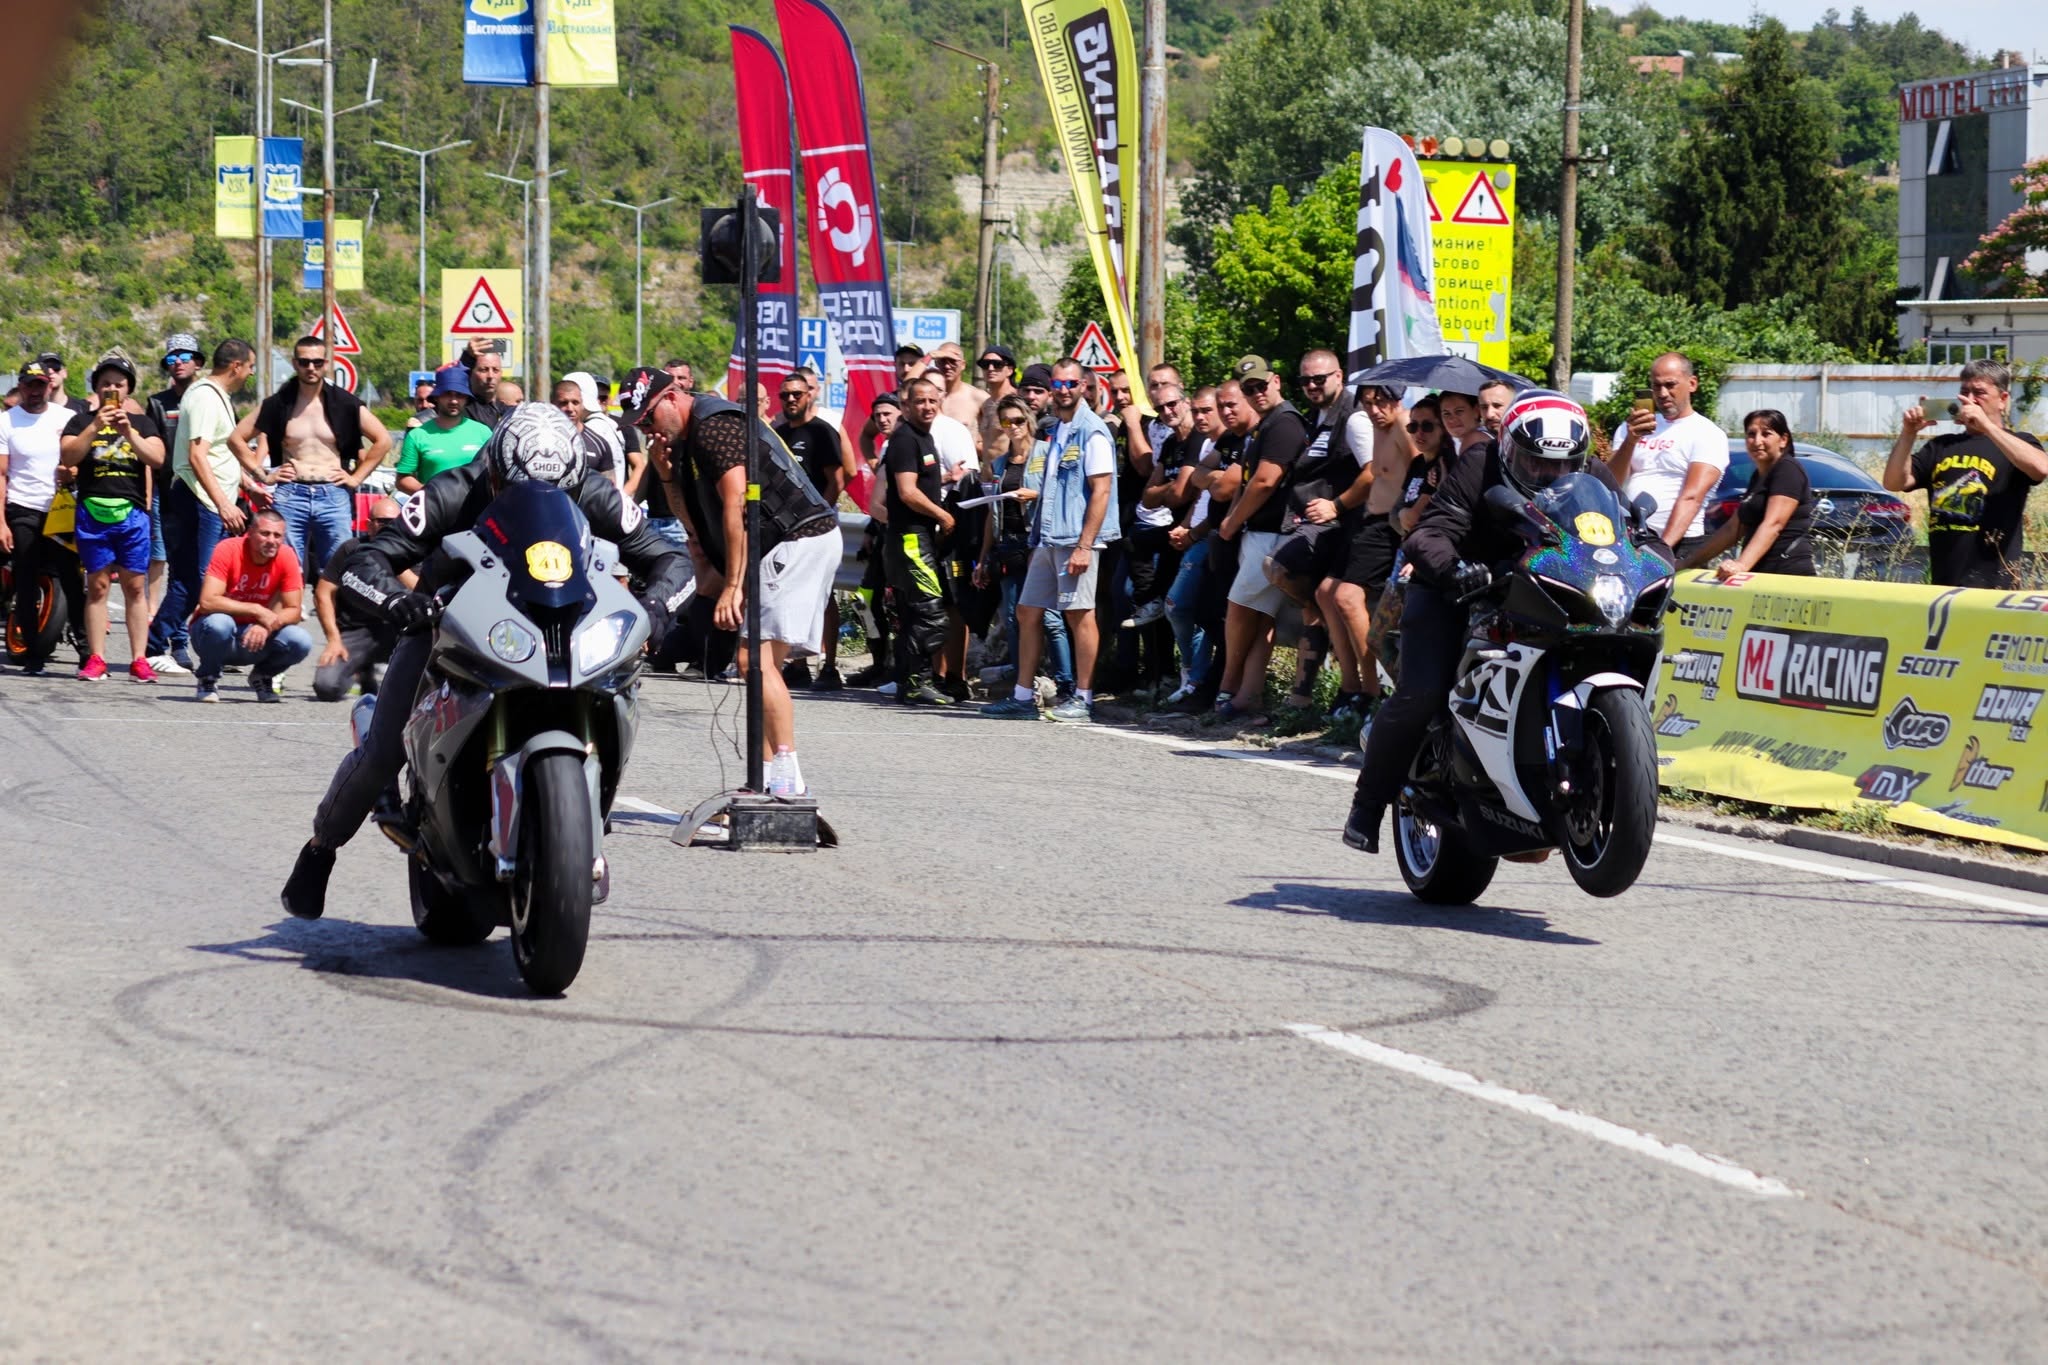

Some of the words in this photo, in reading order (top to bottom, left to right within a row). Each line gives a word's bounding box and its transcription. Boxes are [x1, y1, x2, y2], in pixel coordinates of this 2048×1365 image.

[1900, 80, 1981, 121] MOTEL
[1433, 237, 1492, 250] мание!
[802, 321, 822, 347] H
[917, 327, 942, 338] Ruse
[1541, 440, 1572, 450] HJC
[533, 462, 561, 473] SHOEI
[538, 557, 560, 569] 41
[1691, 571, 1754, 587] L2
[1743, 637, 1775, 691] ML
[1786, 643, 1882, 704] RACING
[1897, 656, 1961, 679] SCOTT
[1658, 712, 1700, 737] thor
[1901, 715, 1946, 743] UFO
[1964, 758, 2014, 789] thor
[1479, 804, 1545, 840] SUZUKI
